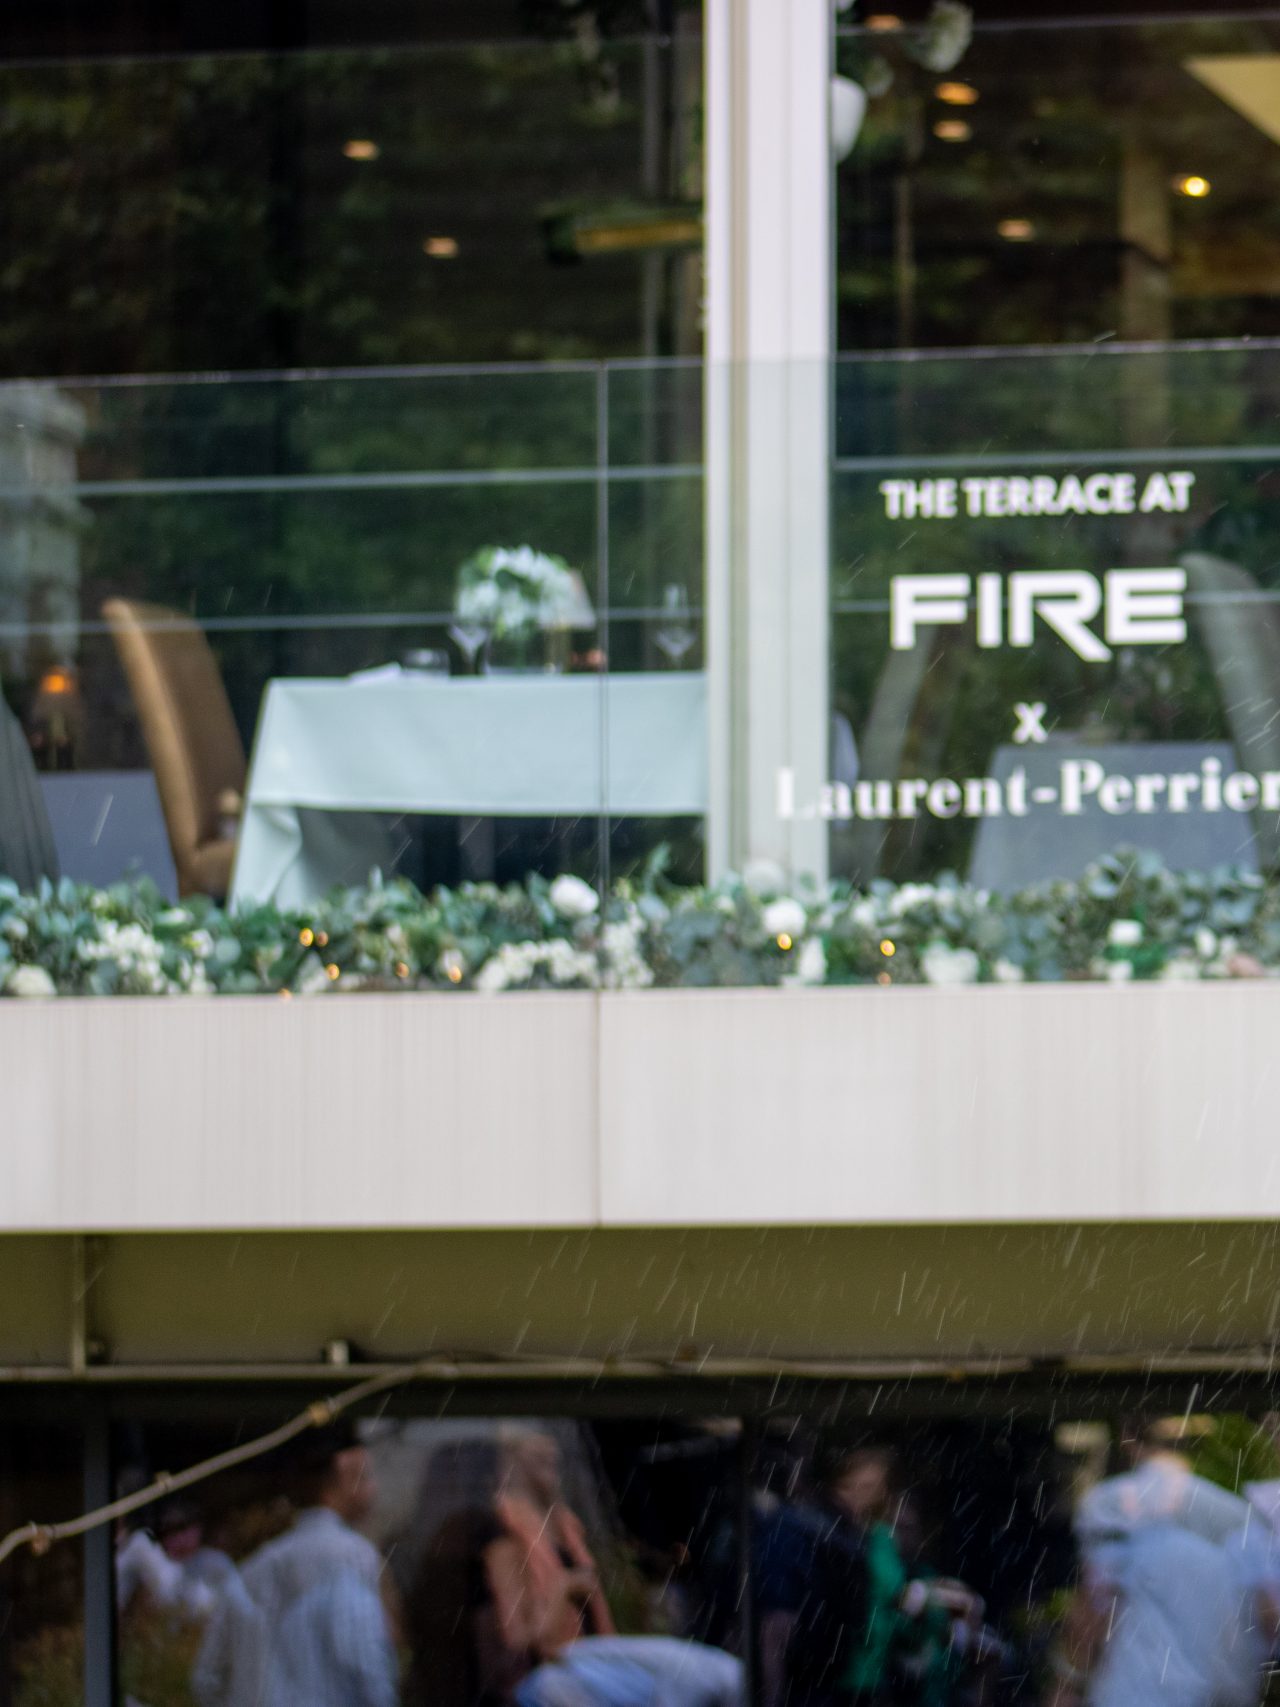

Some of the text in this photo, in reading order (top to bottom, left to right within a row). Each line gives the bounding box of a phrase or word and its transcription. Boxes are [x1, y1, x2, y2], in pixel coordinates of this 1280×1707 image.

[881, 471, 1195, 519] THE TERRACE AT
[890, 567, 1187, 662] FIRE
